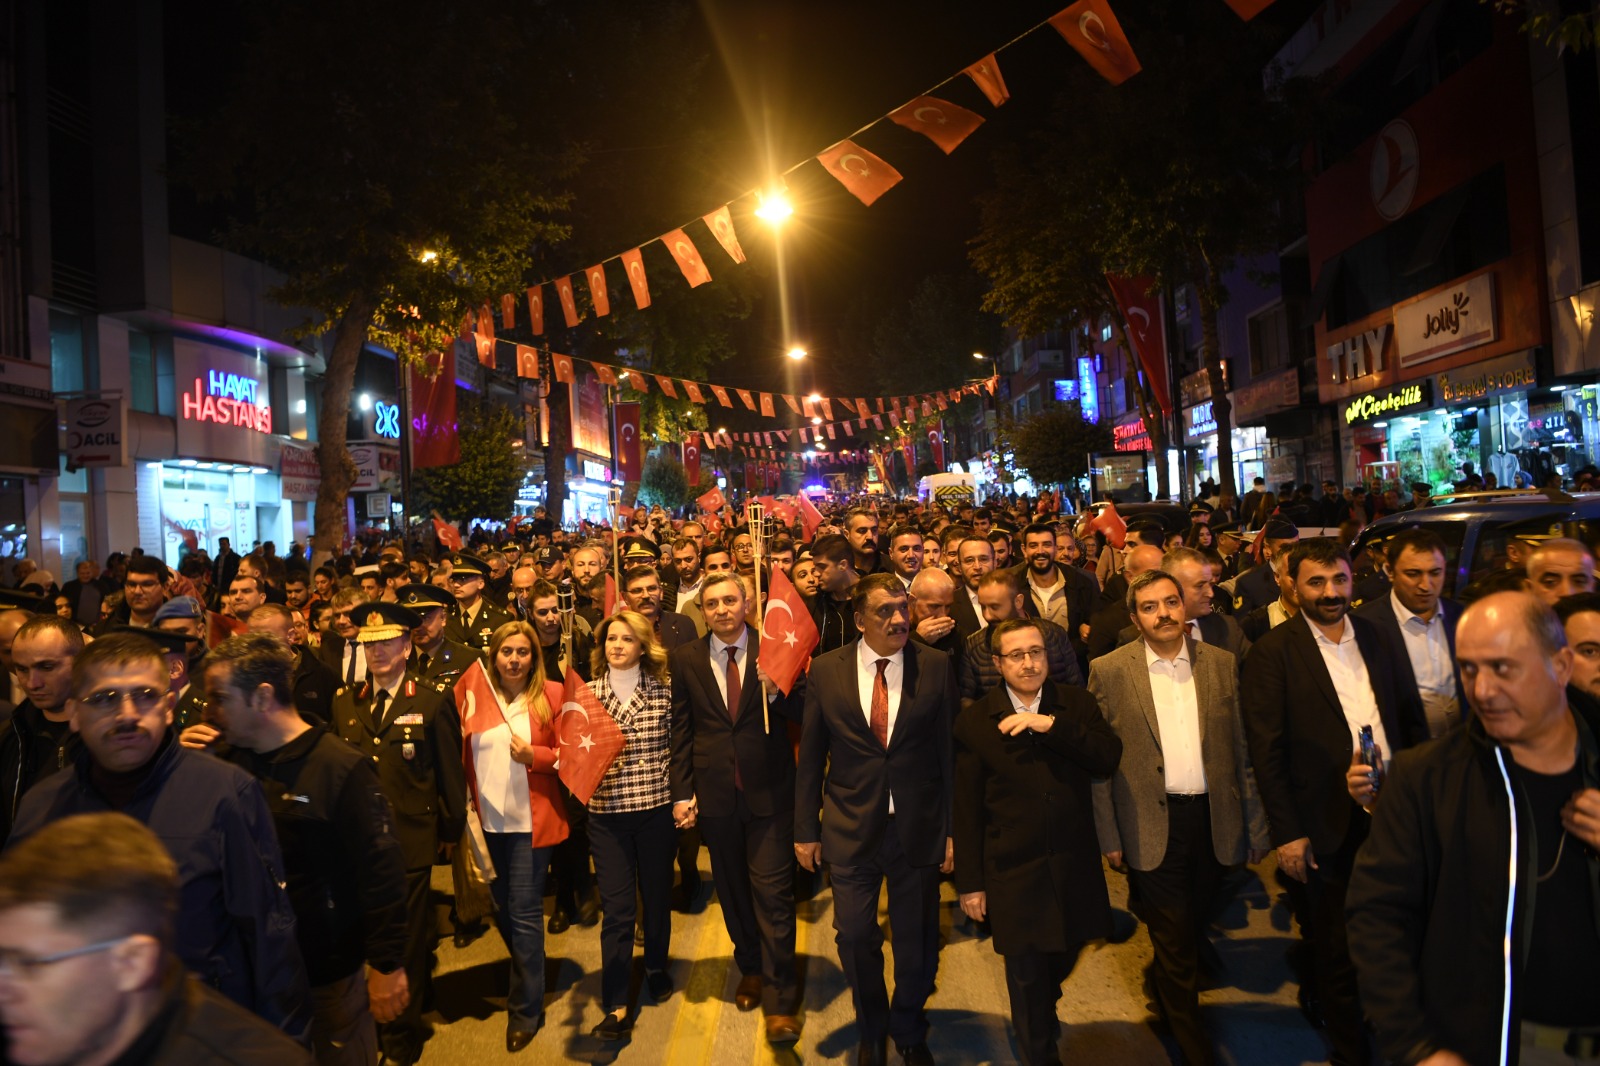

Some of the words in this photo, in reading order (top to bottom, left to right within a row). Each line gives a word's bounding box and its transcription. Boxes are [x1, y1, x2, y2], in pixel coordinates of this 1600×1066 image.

[1423, 307, 1459, 339] Jolly
[1327, 325, 1387, 385] THY
[208, 369, 258, 404] HAYAT
